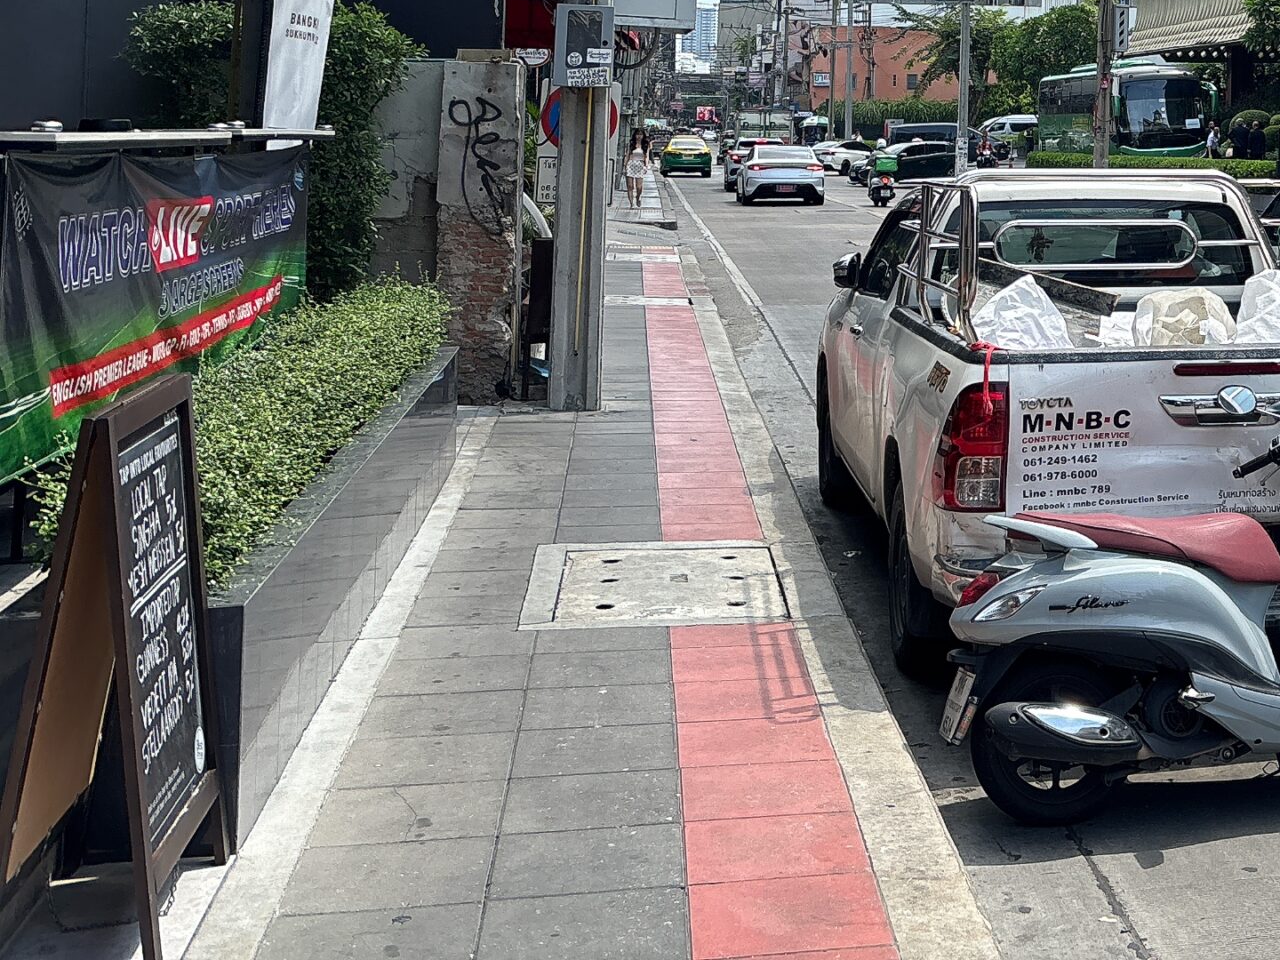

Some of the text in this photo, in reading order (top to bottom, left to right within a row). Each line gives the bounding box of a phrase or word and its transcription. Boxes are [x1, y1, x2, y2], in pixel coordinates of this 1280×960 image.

[157, 203, 211, 265] LIVE
[52, 371, 94, 407] ENGLISH
[92, 361, 124, 392] PREMIER
[122, 350, 149, 382] LEAGUE
[1022, 431, 1130, 444] CONSTRUCTION SERVICE
[1021, 440, 1128, 454] COMPANY LIMITED
[1023, 454, 1098, 468] 061-249-1462
[1022, 469, 1098, 482] 061-978-6000
[131, 464, 168, 520] LOCAL TAP
[1022, 489, 1047, 499] Line
[1056, 486, 1087, 497] mnbc
[1090, 484, 1111, 494] 789
[1022, 501, 1065, 512] Facebook
[1073, 499, 1097, 508] mnbc
[1098, 496, 1155, 507] Construction
[1156, 493, 1190, 503] Service
[131, 504, 162, 559] SINGHA
